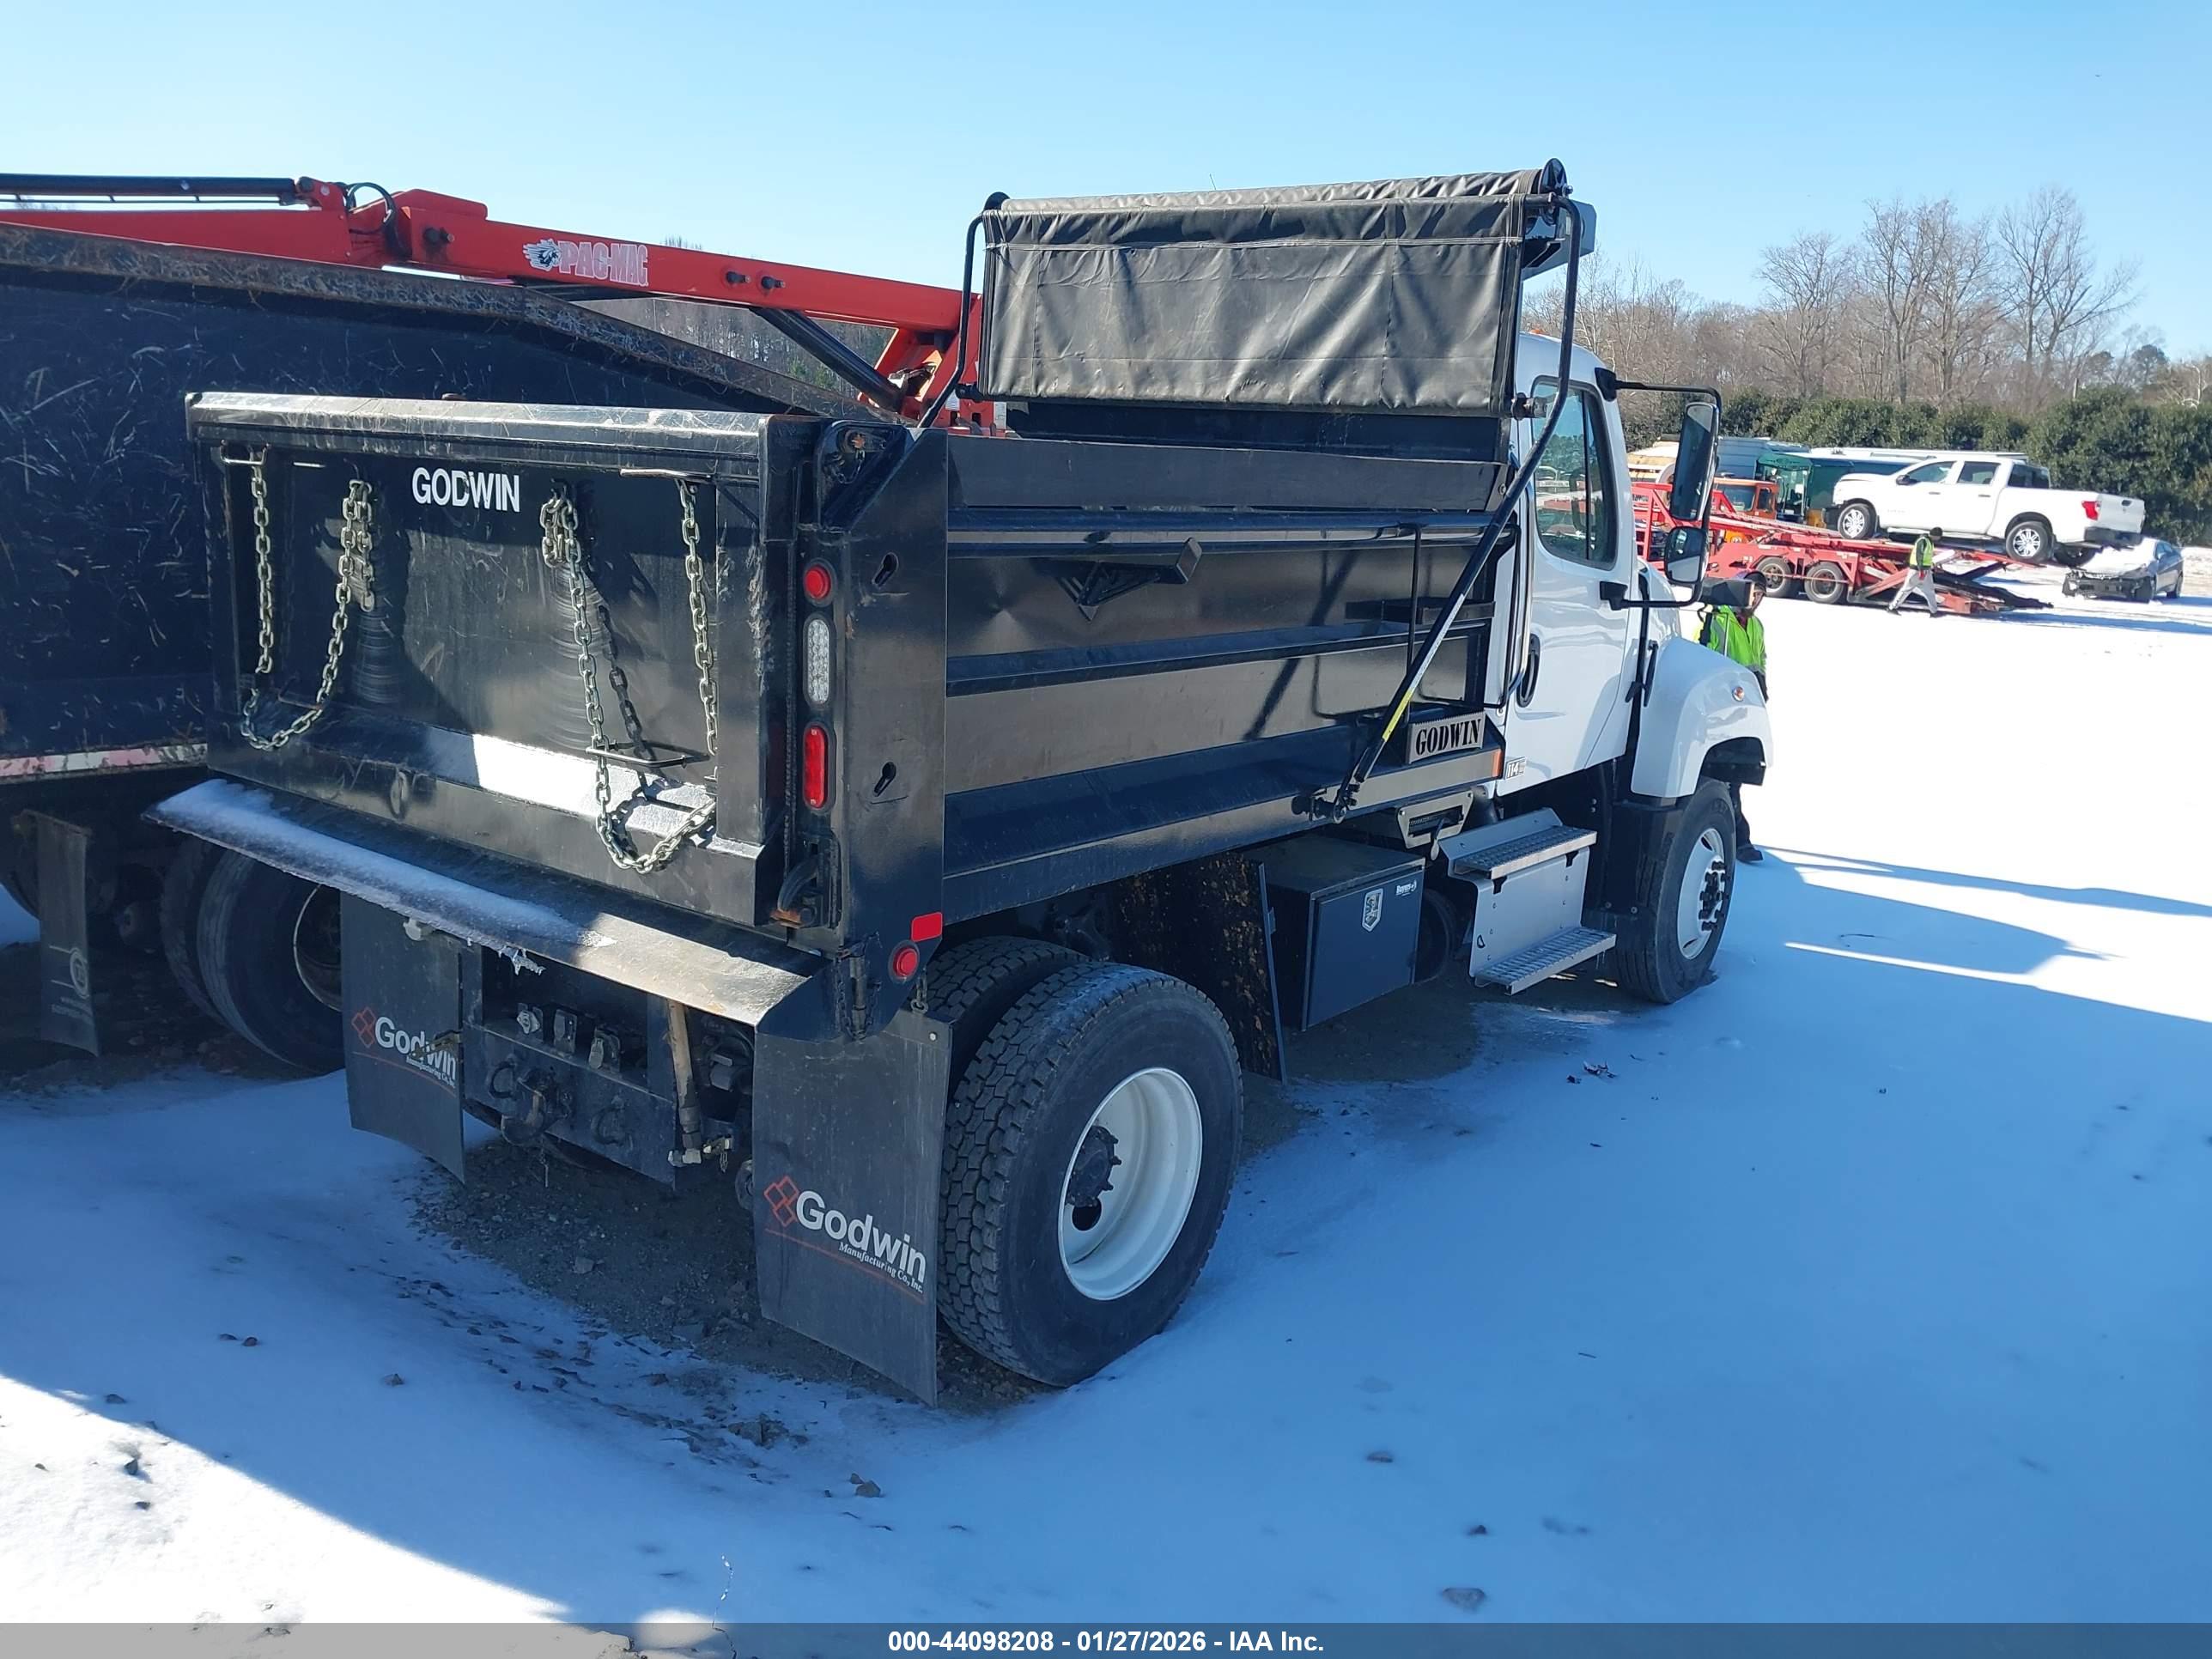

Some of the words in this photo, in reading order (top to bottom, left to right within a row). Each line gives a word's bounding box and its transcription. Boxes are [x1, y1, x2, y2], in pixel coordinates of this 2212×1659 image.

[558, 240, 649, 287] PAC-MAC
[412, 467, 520, 513] GODWIN
[1415, 719, 1481, 756] GODWIN
[797, 1190, 927, 1283] Godwin
[838, 1242, 896, 1279] Manufacturing
